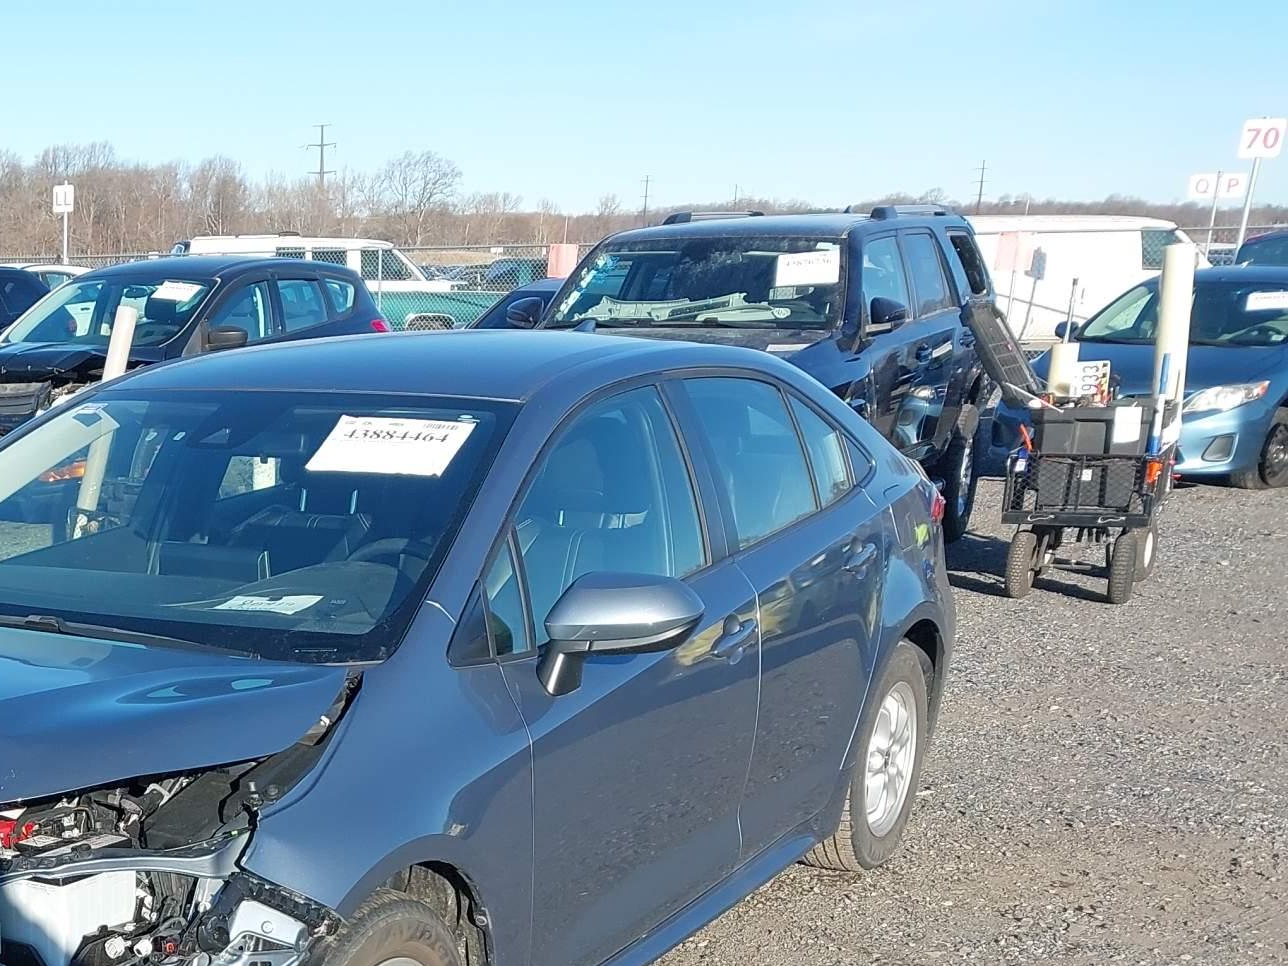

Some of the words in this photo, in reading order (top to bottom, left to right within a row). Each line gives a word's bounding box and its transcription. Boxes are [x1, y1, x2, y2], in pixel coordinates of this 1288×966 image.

[1246, 127, 1280, 149] 70
[1195, 178, 1209, 194] Q
[1226, 178, 1240, 193] P
[55, 190, 72, 206] LL
[343, 428, 450, 443] 43884464
